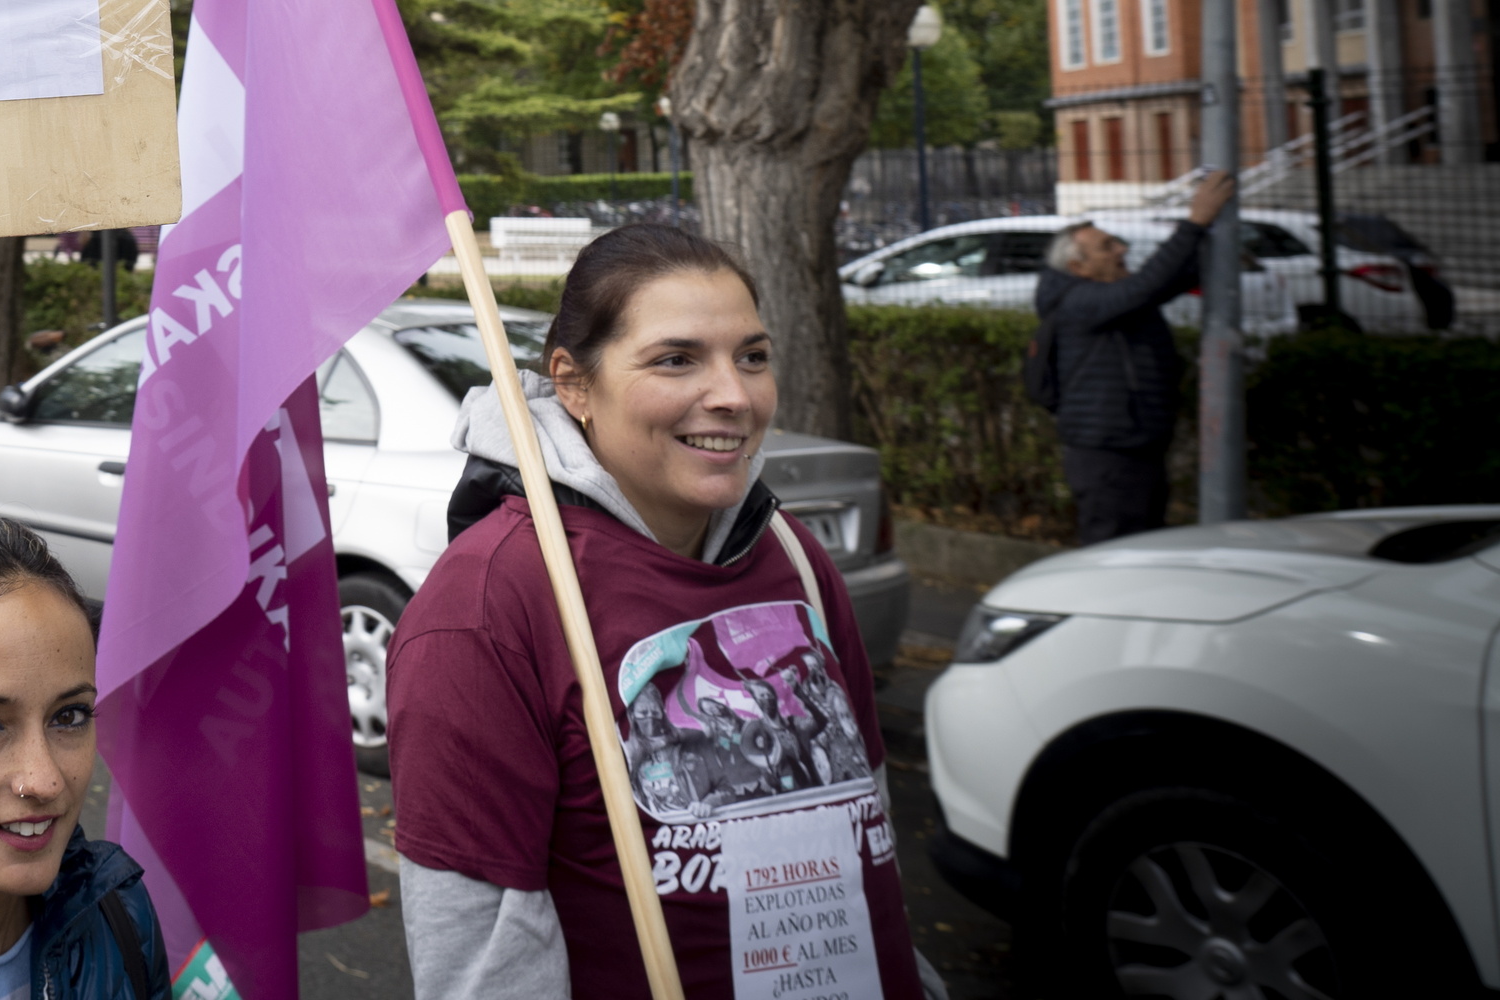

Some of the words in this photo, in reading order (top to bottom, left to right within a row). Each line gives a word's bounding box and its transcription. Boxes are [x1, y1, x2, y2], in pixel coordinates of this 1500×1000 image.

[745, 866, 780, 889] 1792
[782, 855, 841, 883] HORAS
[744, 882, 846, 915] EXPLOTADAS
[747, 921, 771, 942] AL
[775, 911, 813, 936] AÑO
[817, 907, 849, 928] POR
[742, 947, 778, 969] 1000
[782, 943, 793, 963] €
[797, 941, 820, 962] AL
[823, 934, 859, 957] MES
[772, 966, 838, 999] ¿HASTA
